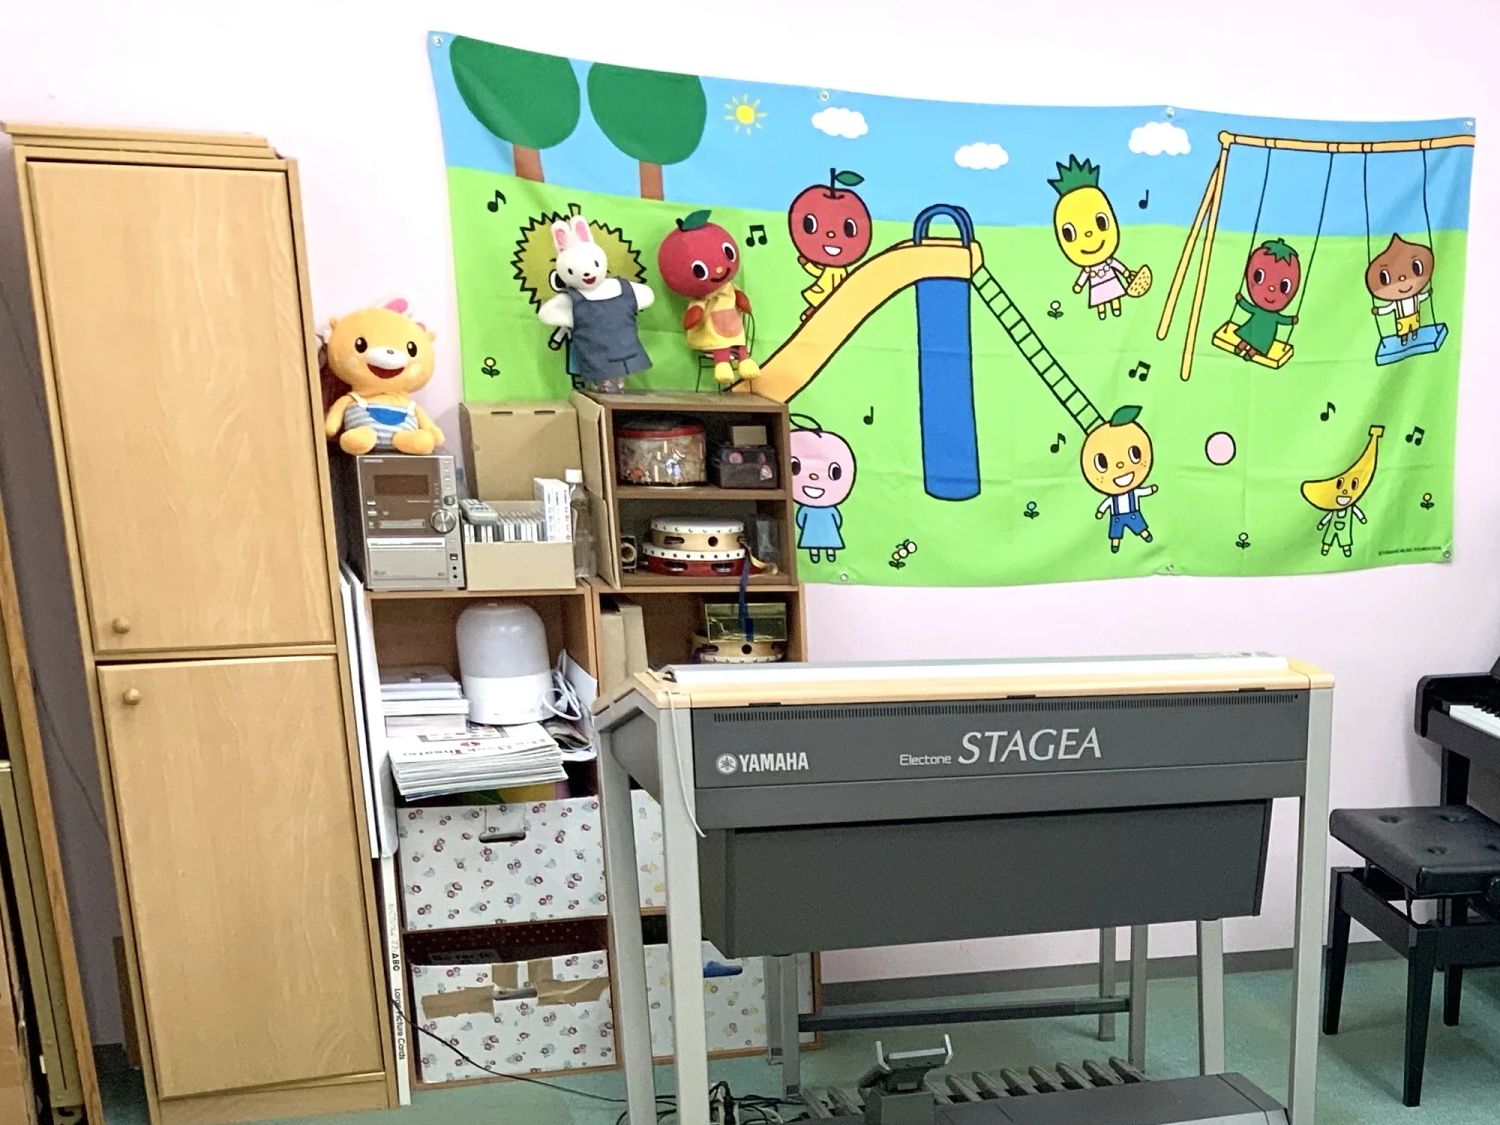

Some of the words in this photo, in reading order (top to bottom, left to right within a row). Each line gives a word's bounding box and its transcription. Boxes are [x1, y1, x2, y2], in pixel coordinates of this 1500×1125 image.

[900, 753, 953, 767] Electone
[957, 726, 1102, 765] STAGEA
[739, 752, 810, 772] YAMAHA
